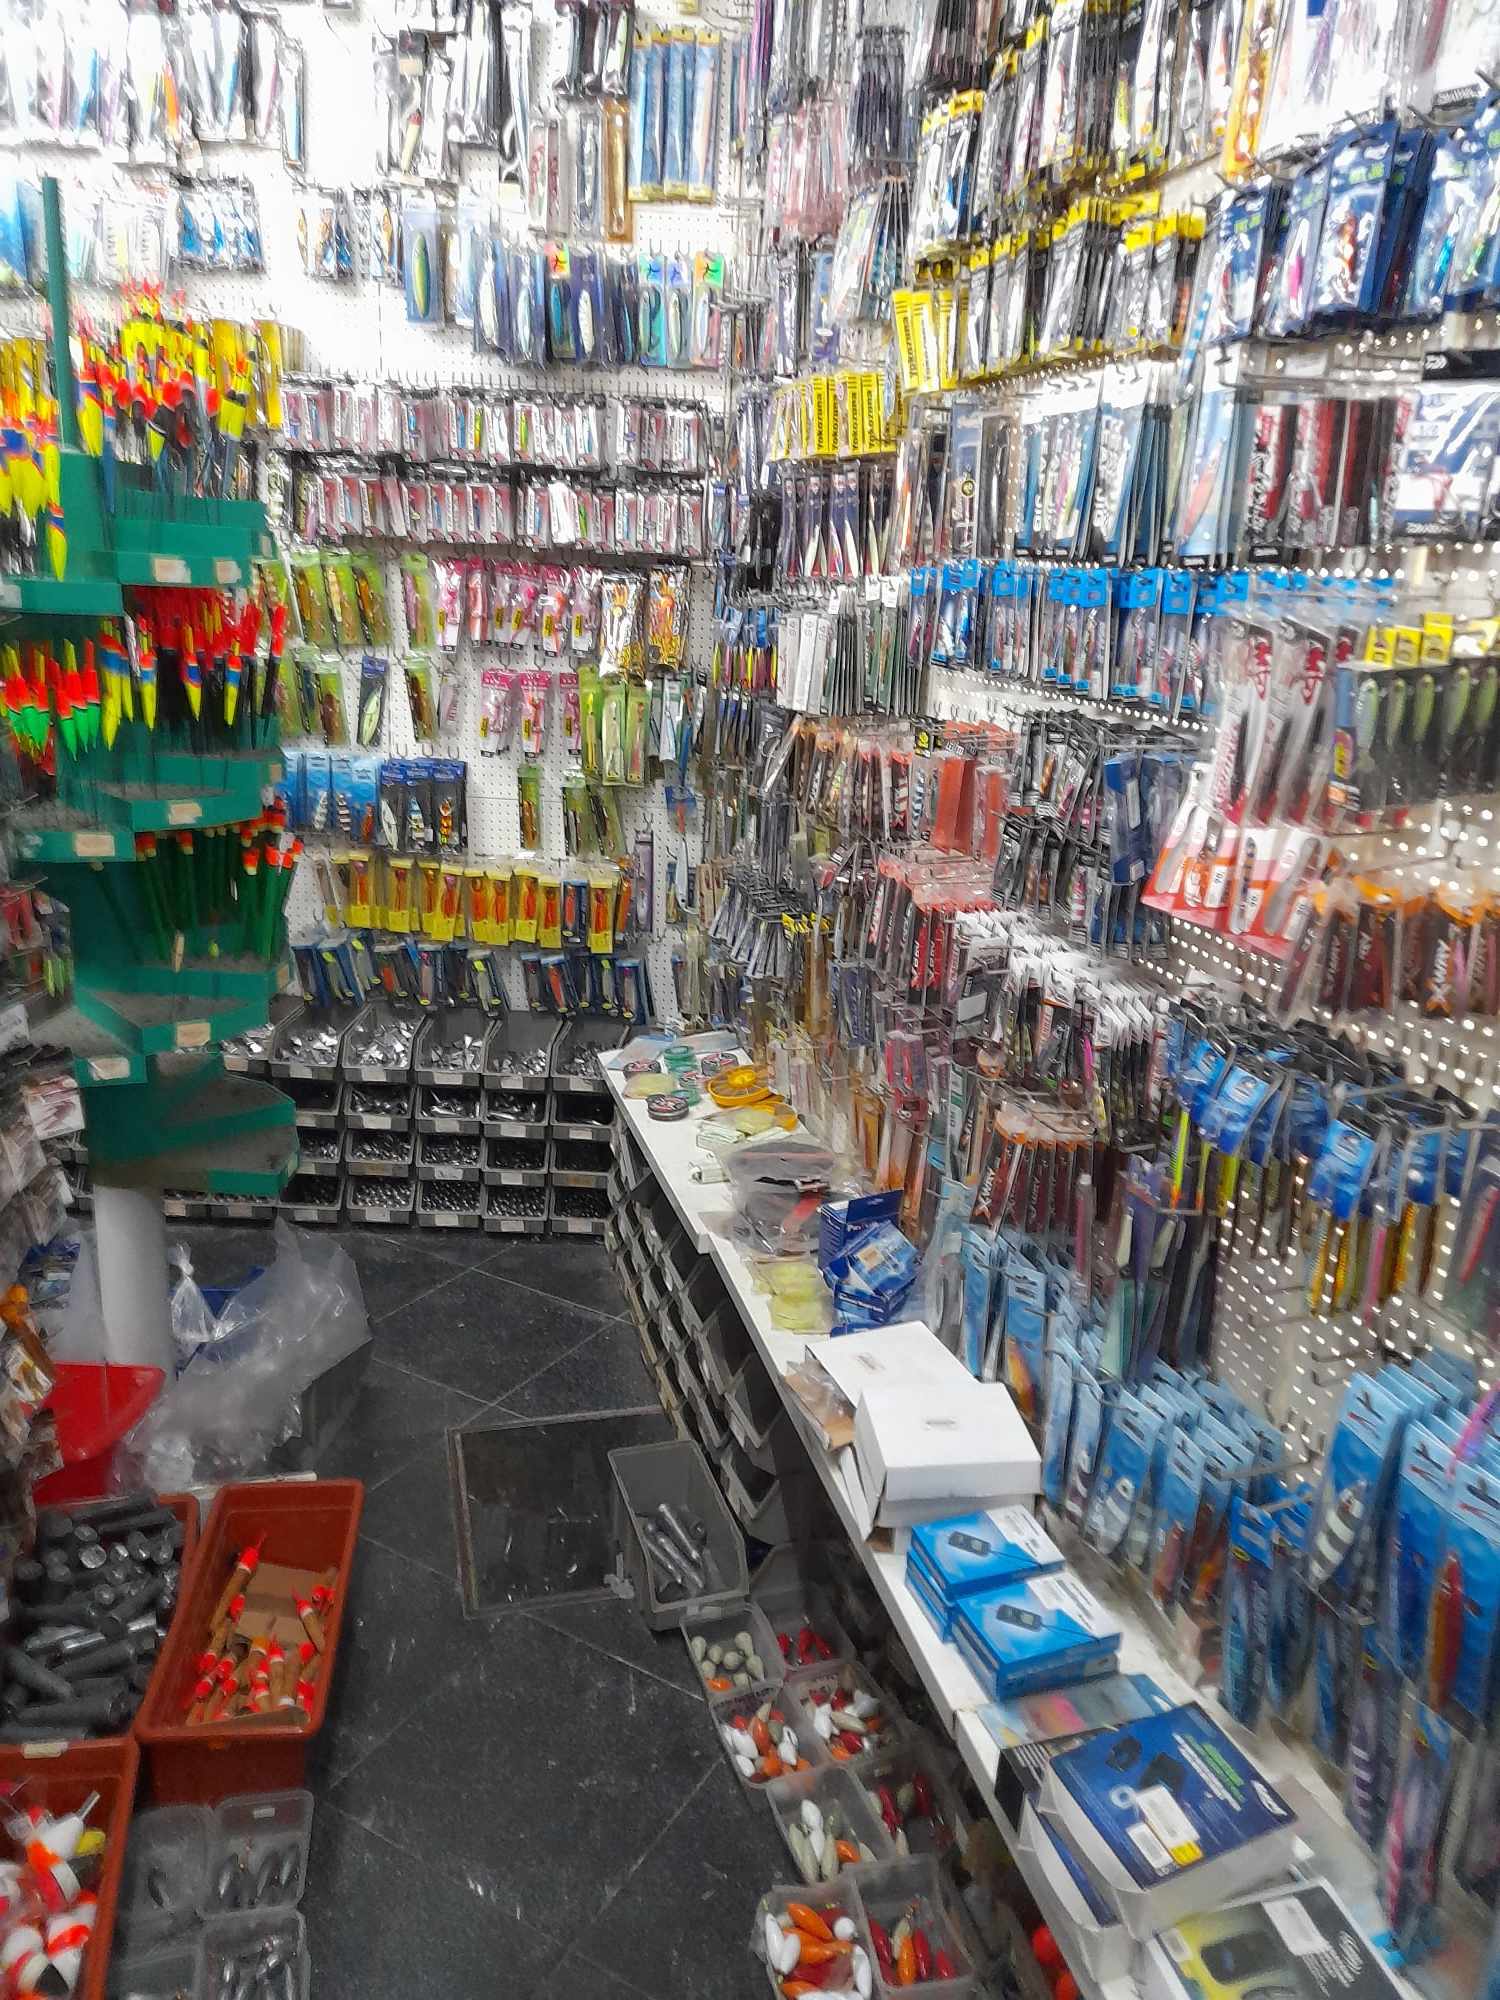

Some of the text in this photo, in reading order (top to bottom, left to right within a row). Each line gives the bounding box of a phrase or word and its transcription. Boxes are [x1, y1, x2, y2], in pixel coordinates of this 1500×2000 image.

[815, 393, 824, 451] Yokozuna
[851, 392, 859, 450] Yokozuna
[866, 390, 876, 449] Yokozuna
